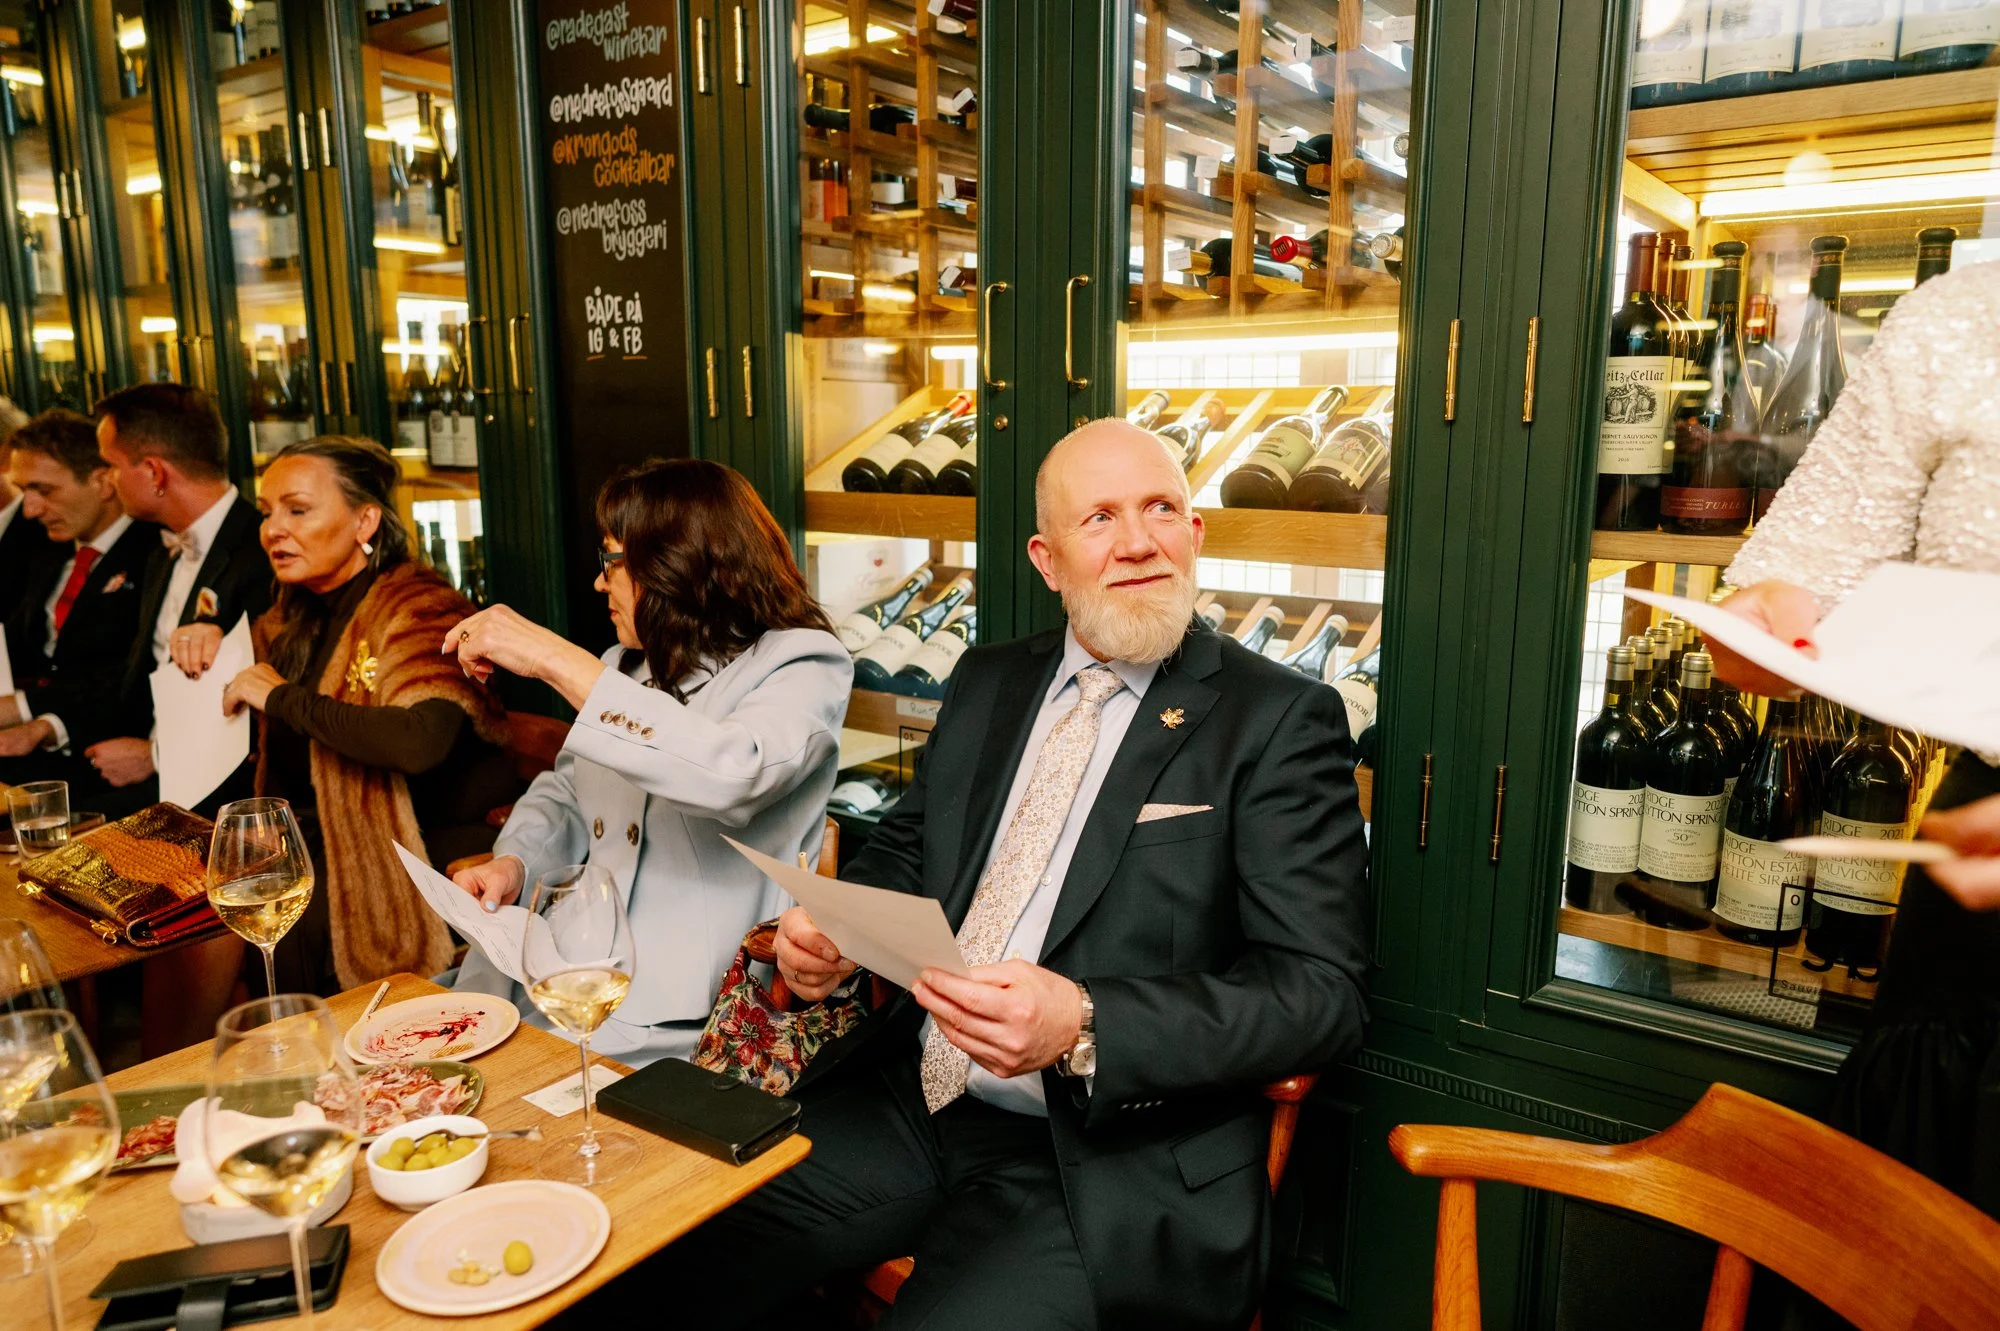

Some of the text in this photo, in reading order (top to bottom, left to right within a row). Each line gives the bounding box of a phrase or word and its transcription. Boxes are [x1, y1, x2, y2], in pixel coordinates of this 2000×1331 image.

[546, 1, 630, 51] @radegast
[603, 25, 667, 62] winebar
[602, 219, 667, 261] bryggeri
[584, 285, 643, 328] BÅDE PÅ
[588, 326, 643, 354] IG & FB
[1606, 370, 1625, 383] eitz
[1575, 786, 1601, 804] IDGE
[1574, 799, 1607, 817] YTTON
[1823, 817, 1863, 838] RIDGE
[1879, 828, 1905, 841] 2021
[1725, 835, 1757, 855] RIDGE
[1722, 861, 1755, 882] PETITE
[1758, 873, 1801, 886] SIRAH
[1770, 860, 1807, 873] ESTATE
[1817, 859, 1899, 883] SAUVIGNON
